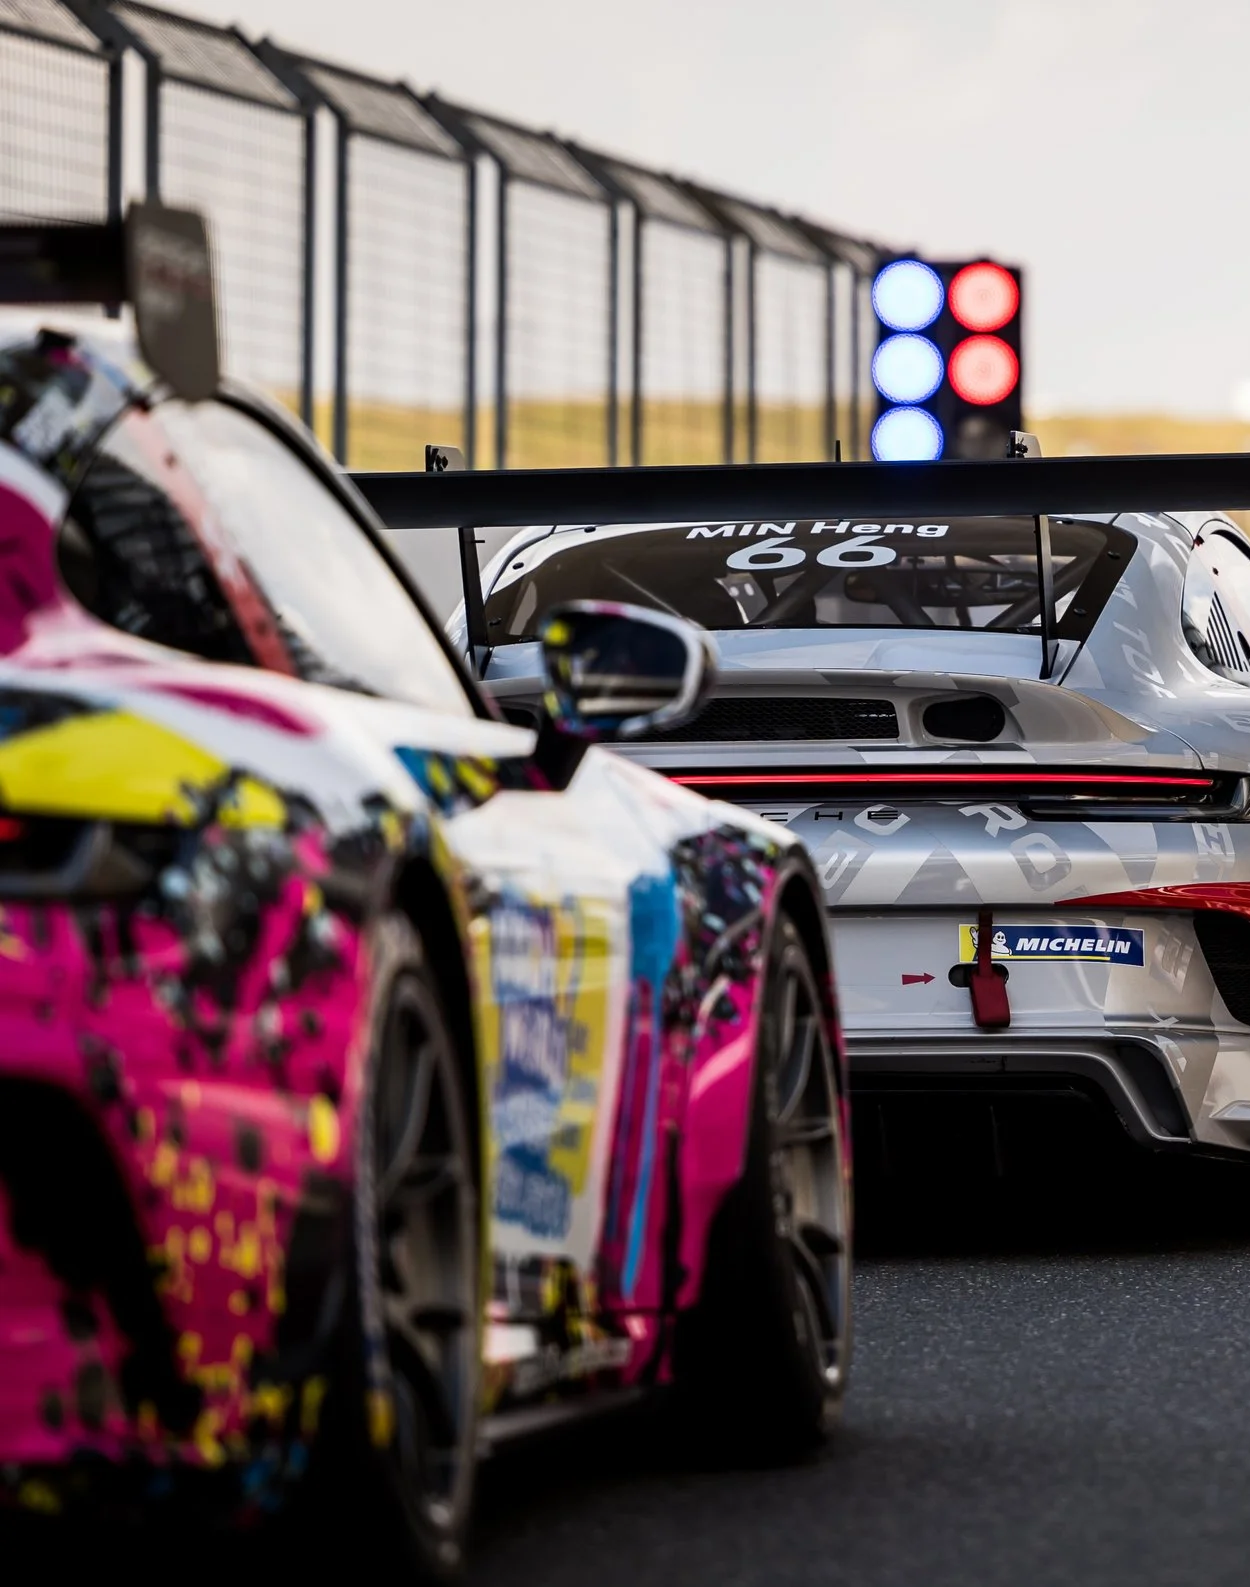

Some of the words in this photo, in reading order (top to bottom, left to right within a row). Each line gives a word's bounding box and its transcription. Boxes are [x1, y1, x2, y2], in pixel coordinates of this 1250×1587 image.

[686, 522, 796, 539] MIN
[810, 521, 950, 538] Heng
[726, 535, 897, 570] 66
[760, 810, 899, 821] CHE
[1015, 937, 1131, 954] MICHELIN
